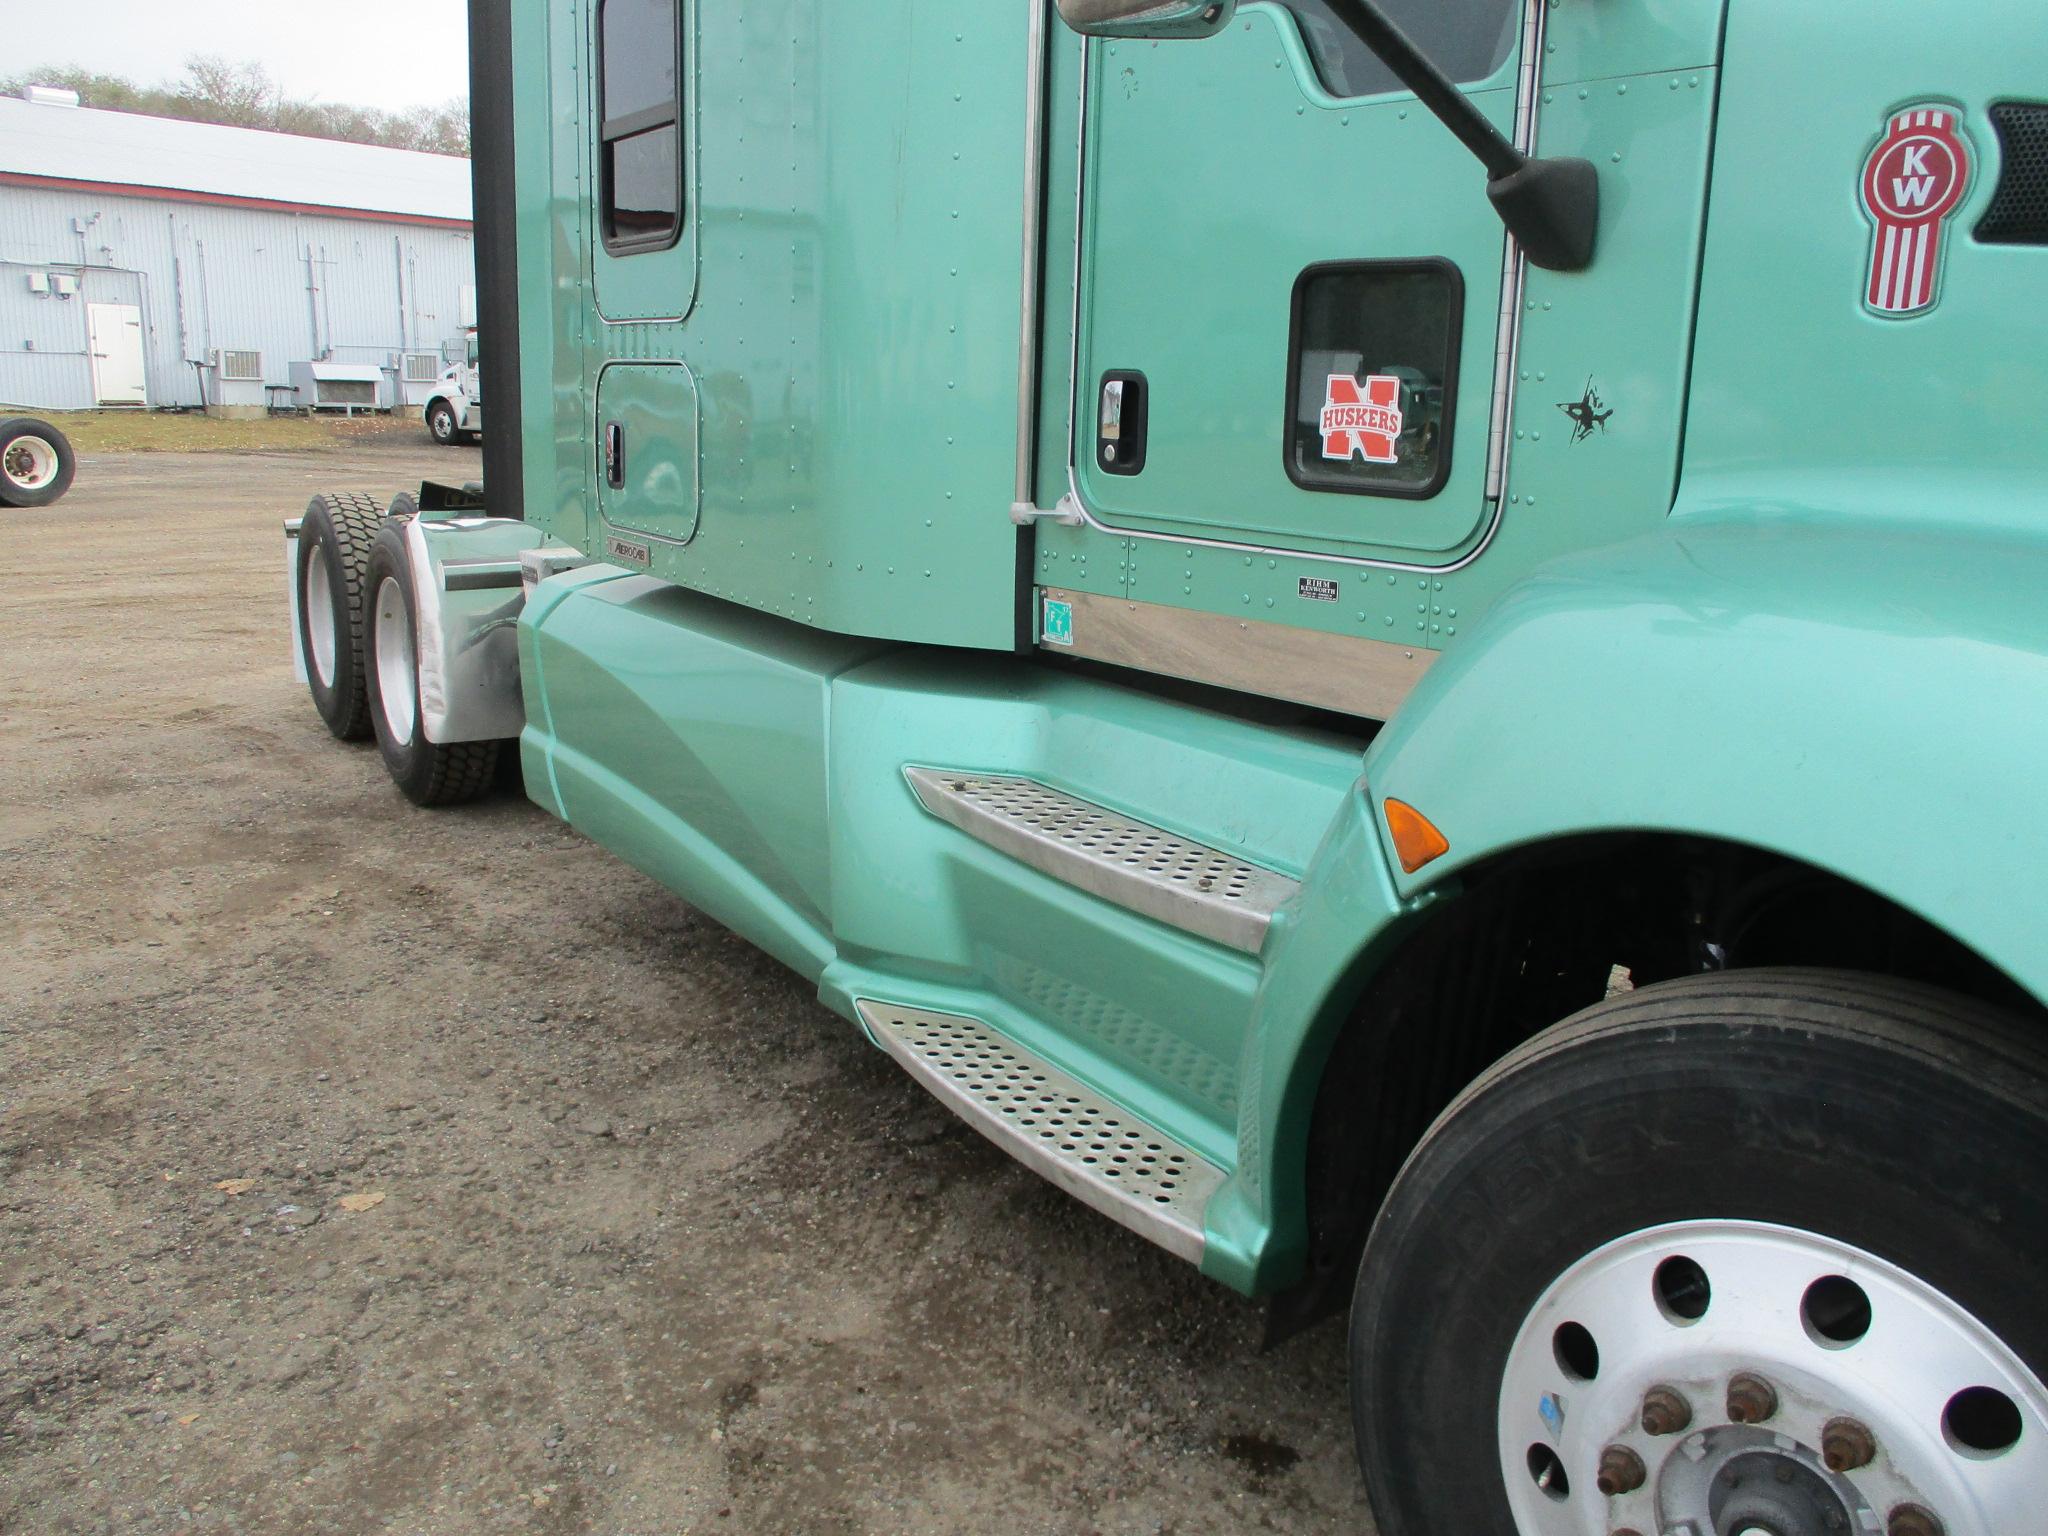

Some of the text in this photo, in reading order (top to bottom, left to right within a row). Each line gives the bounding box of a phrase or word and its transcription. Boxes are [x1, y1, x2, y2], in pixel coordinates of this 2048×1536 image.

[1902, 144, 1932, 177] K
[1892, 175, 1936, 207] W
[1322, 407, 1399, 434] HUSKERS
[1325, 377, 1397, 460] N
